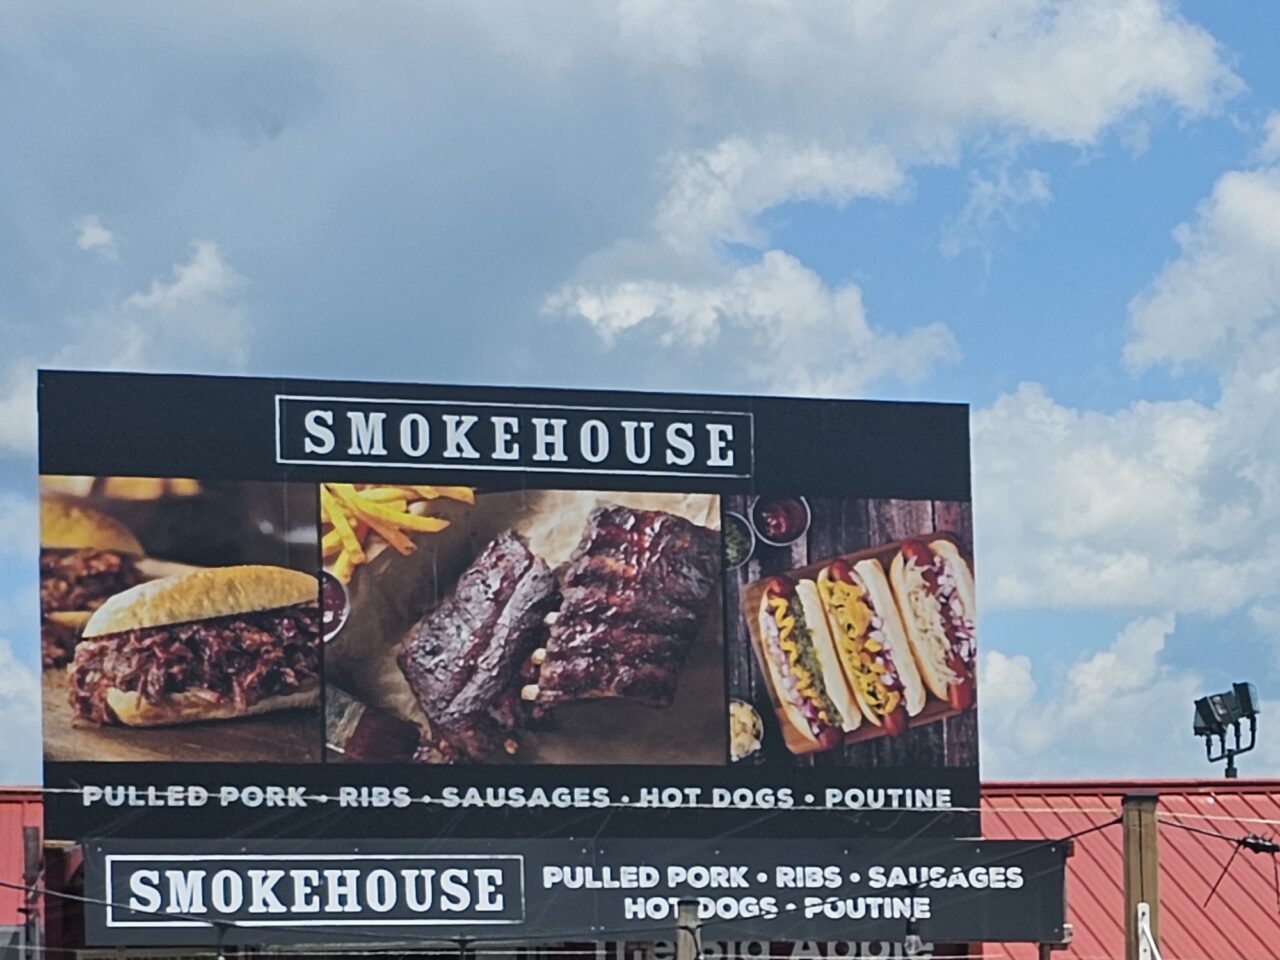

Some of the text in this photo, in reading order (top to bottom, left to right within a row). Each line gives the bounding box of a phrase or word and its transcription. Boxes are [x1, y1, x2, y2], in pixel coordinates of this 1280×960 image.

[304, 410, 735, 467] SMOKEHOUSE
[83, 786, 952, 809] PULLED PORK RIBS SAUSAGES HOT DOGS POUTINE
[543, 866, 1024, 889] PULLED PORK RIBS SAUSAGES
[129, 869, 504, 914] SMOKEHOUSE
[624, 896, 931, 920] HOT DOGS POUTINE
